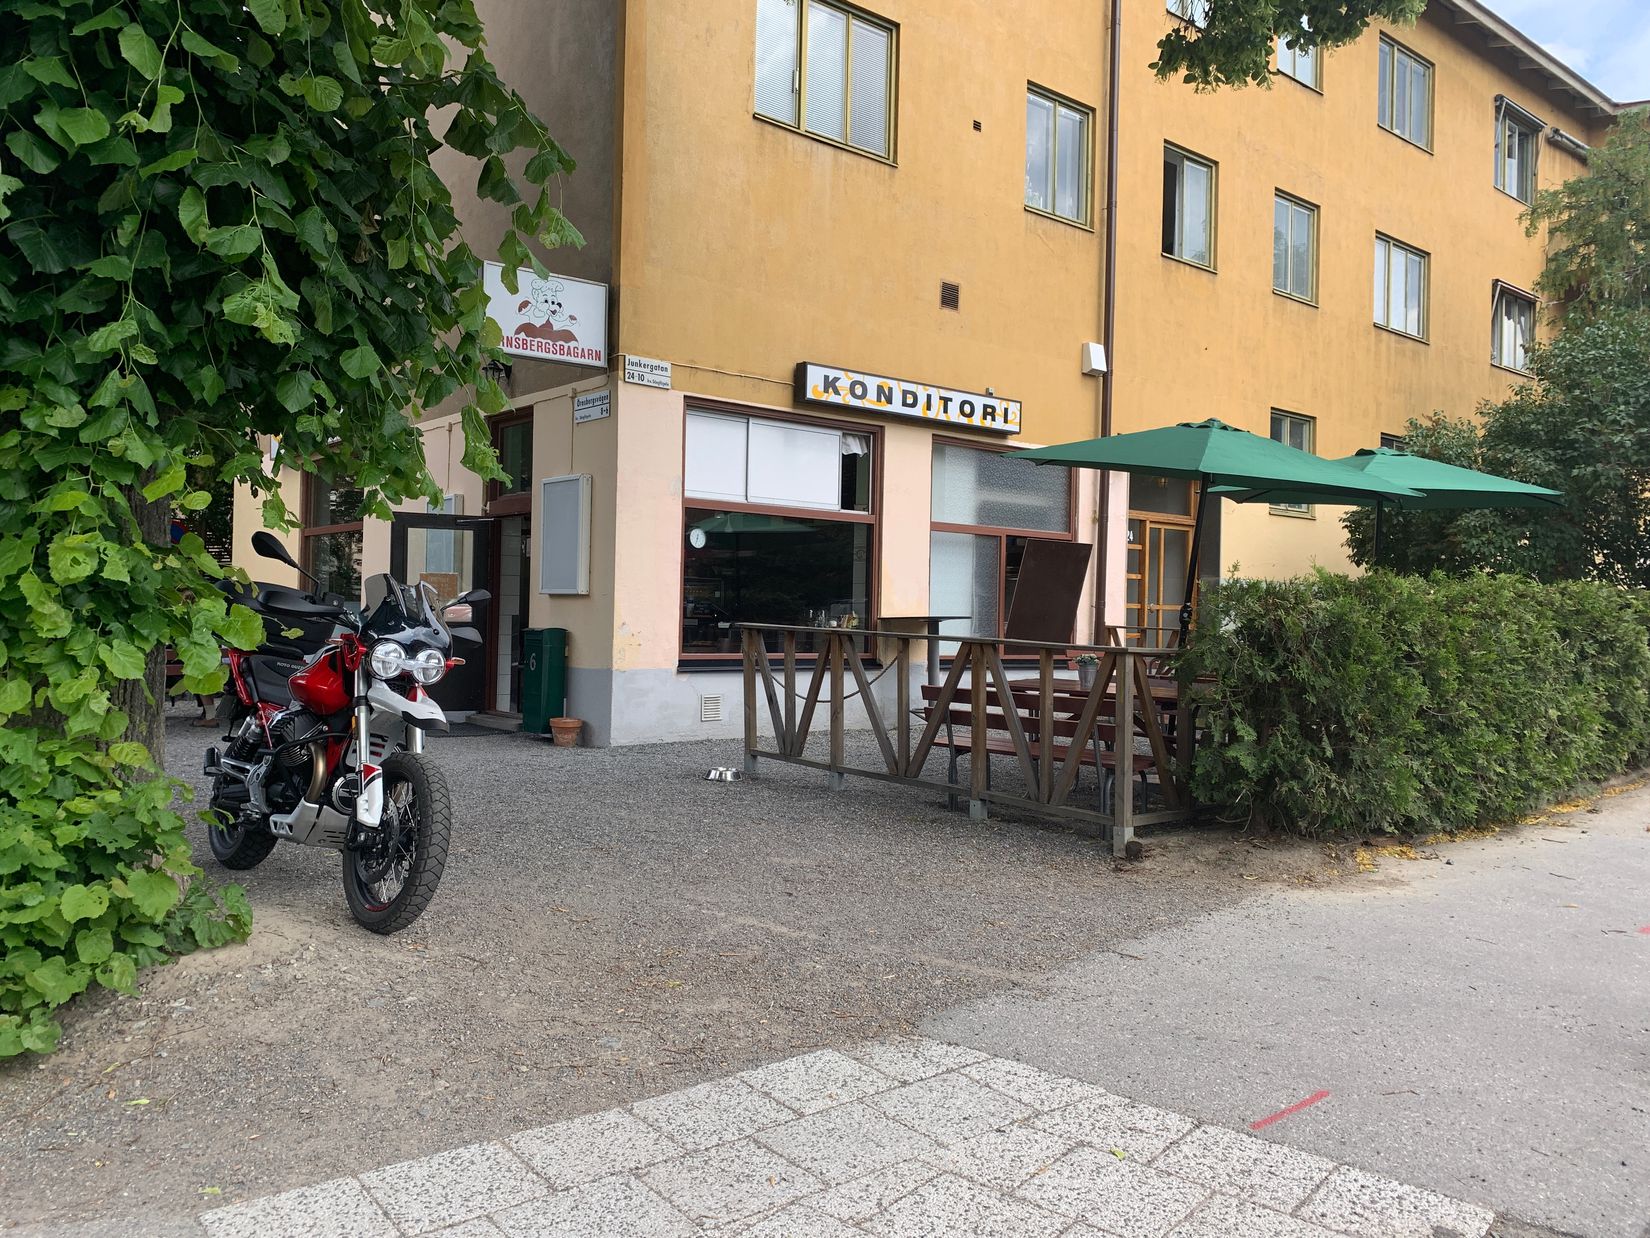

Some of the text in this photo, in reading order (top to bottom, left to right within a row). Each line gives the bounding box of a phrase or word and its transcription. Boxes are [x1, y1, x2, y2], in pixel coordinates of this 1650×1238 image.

[627, 358, 669, 373] Junkergatan
[823, 374, 1009, 424] KONDITORI
[529, 652, 536, 671] 6
